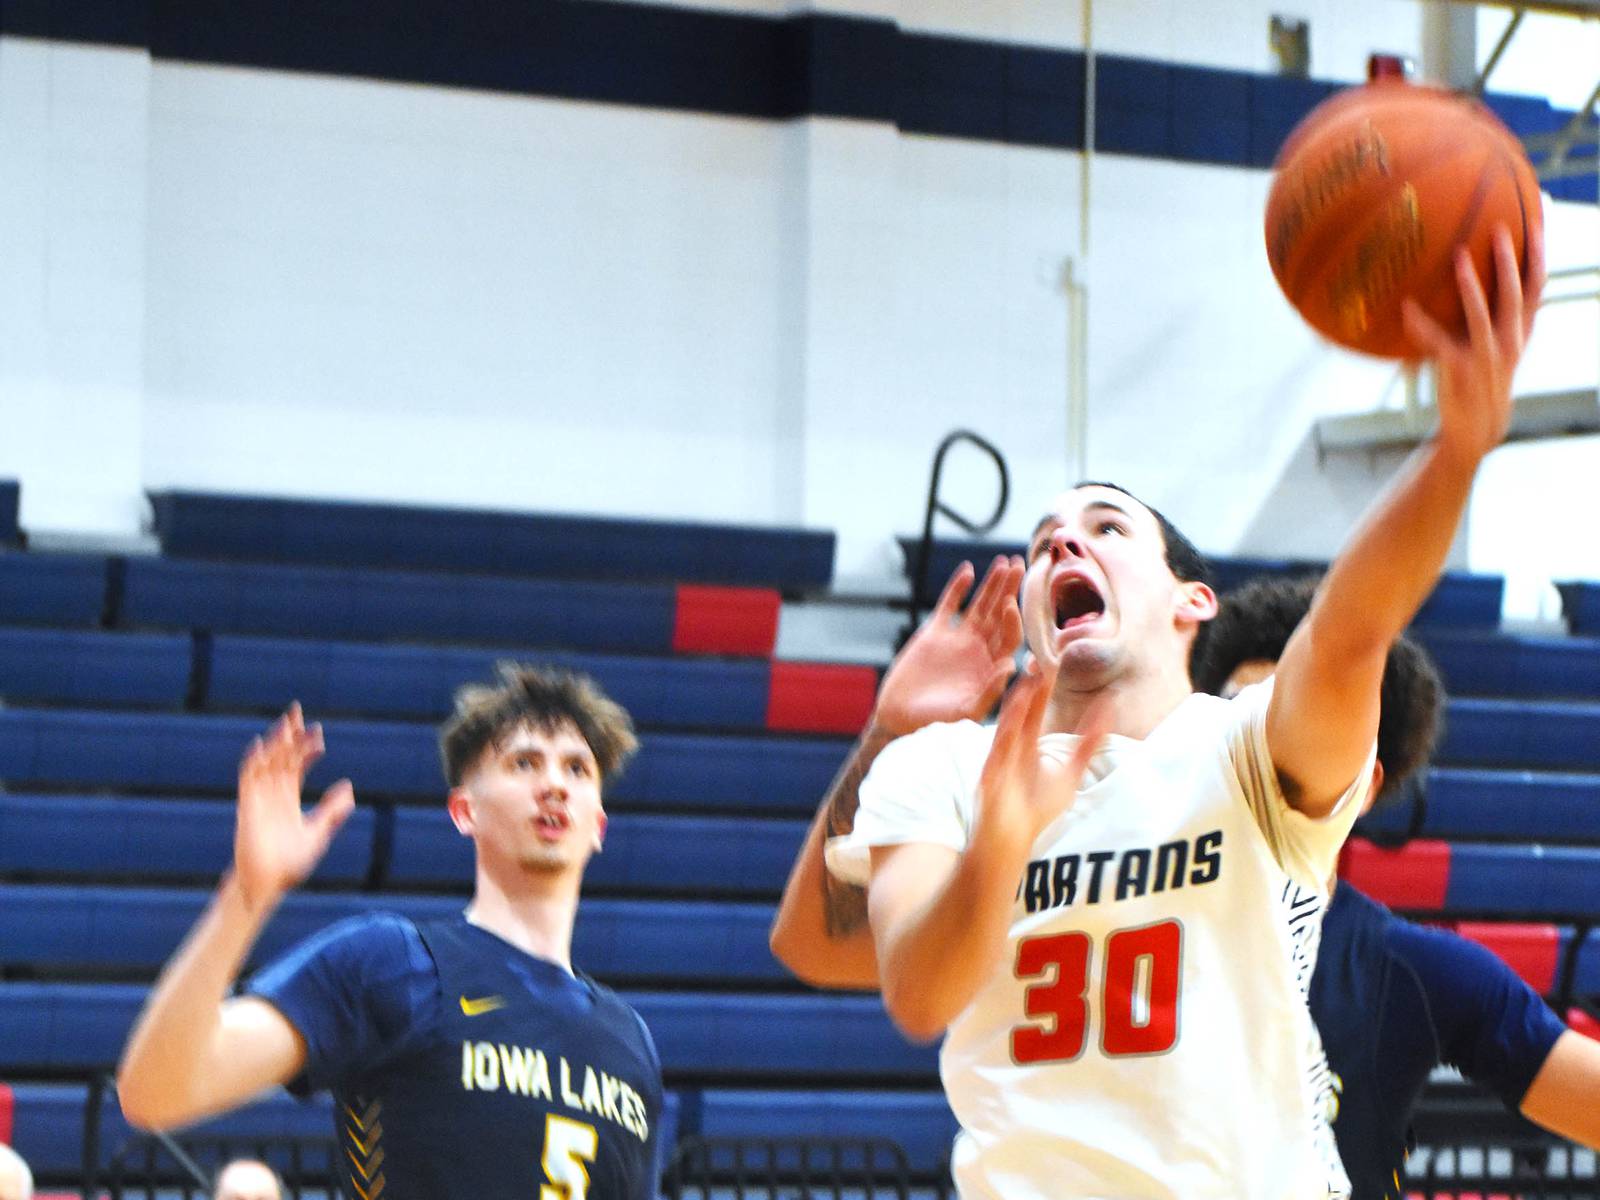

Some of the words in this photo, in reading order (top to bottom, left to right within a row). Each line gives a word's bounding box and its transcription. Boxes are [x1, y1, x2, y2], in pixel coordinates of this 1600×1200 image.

[1015, 830, 1223, 914] ARTANS
[1009, 917, 1185, 1067] 30
[462, 1040, 553, 1102] IOWA
[560, 1056, 649, 1143] LAKES
